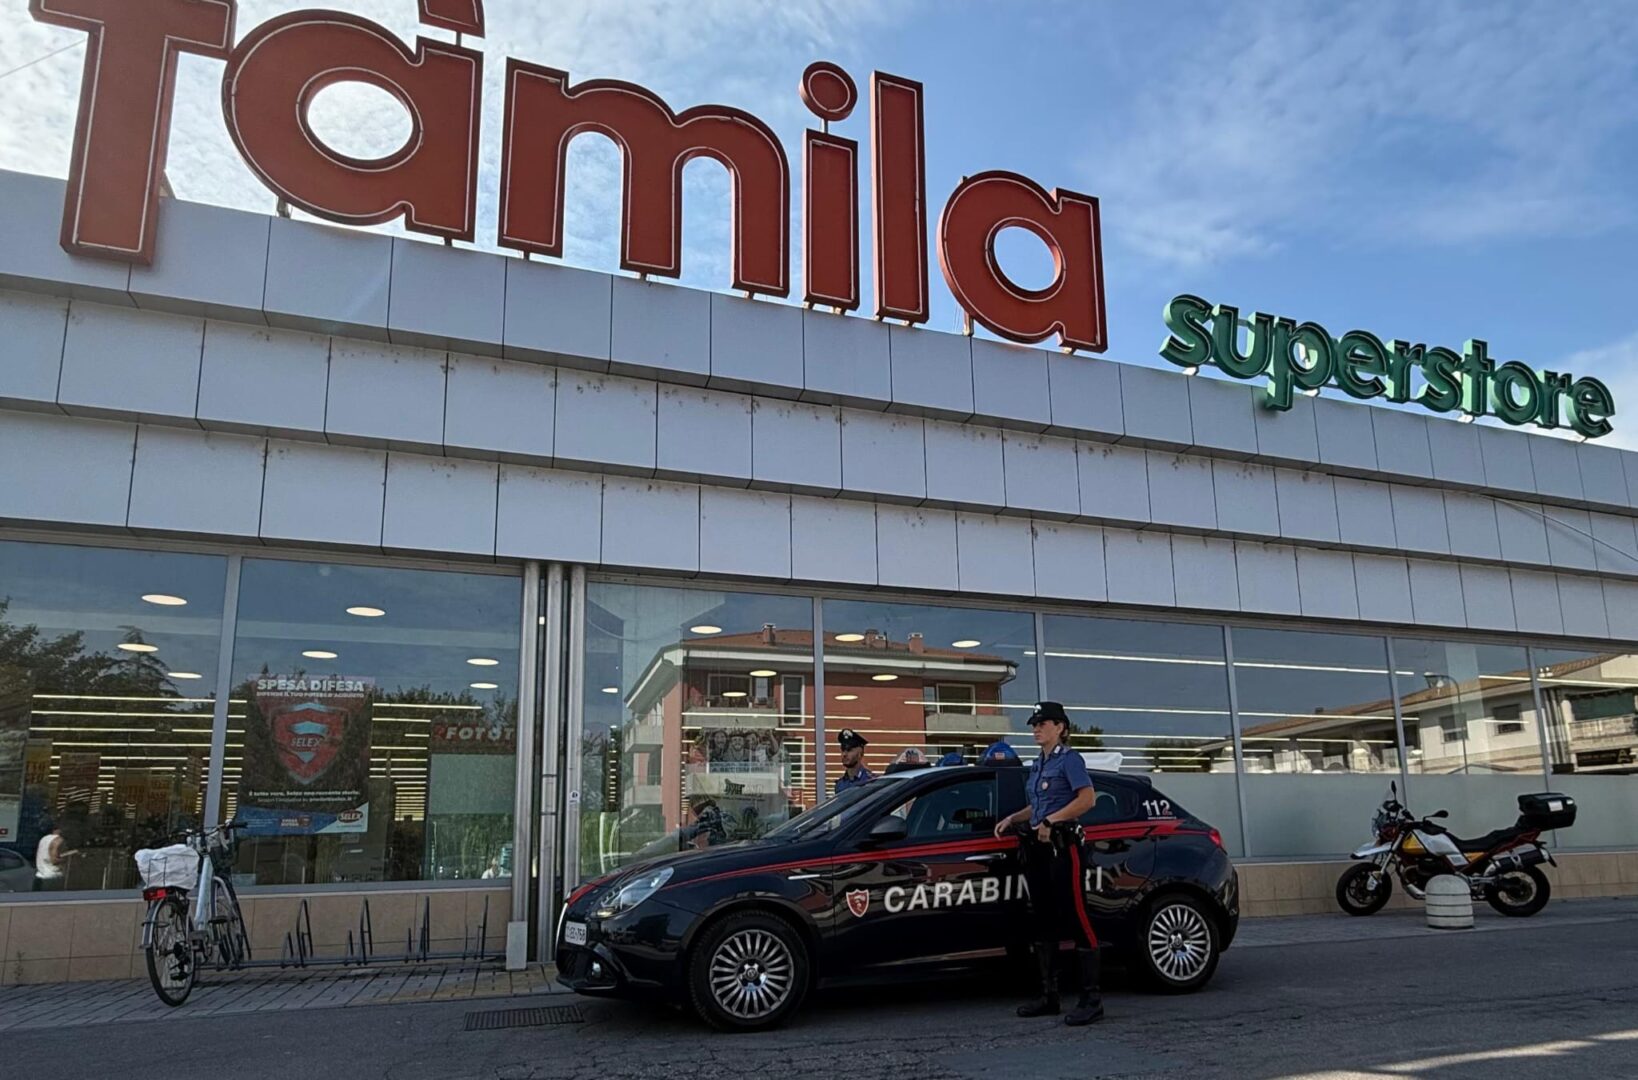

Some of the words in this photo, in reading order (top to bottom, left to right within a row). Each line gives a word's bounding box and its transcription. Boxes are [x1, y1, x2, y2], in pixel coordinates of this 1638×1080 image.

[1159, 294, 1616, 438] superstore
[257, 679, 308, 691] SPESA
[311, 680, 364, 692] DIFESA
[291, 737, 321, 747] SELEX
[1142, 799, 1173, 816] 112
[884, 866, 1103, 913] CARABINI
